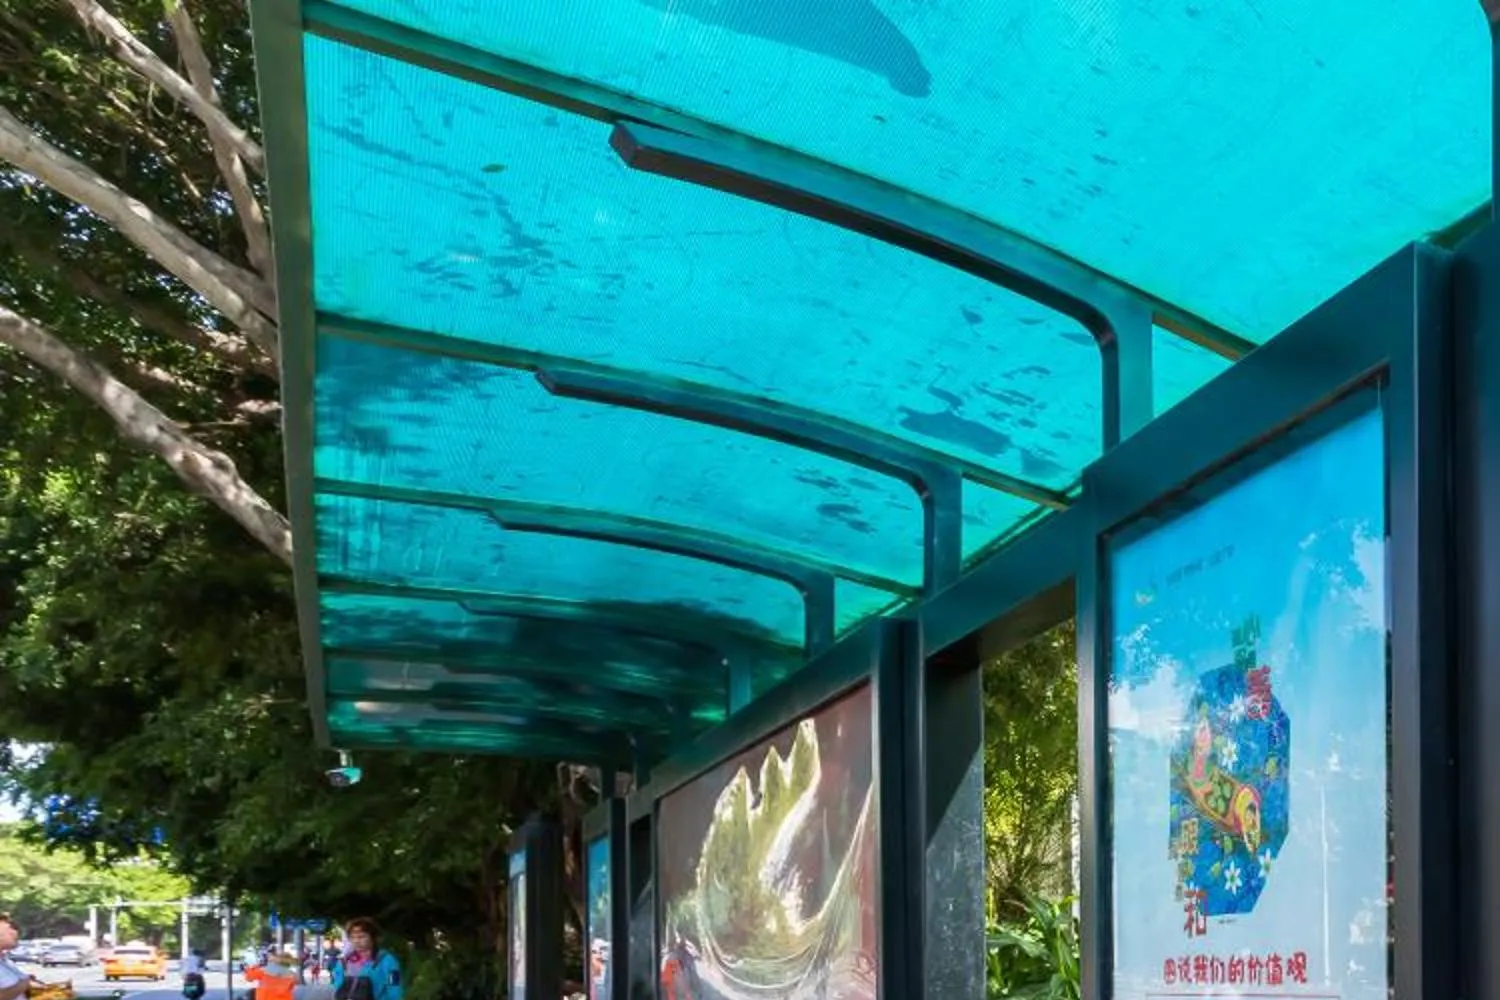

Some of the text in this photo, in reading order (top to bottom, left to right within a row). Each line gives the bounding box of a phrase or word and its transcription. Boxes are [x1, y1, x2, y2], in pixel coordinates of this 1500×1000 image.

[1163, 951, 1307, 985] 图说我们的价值观
